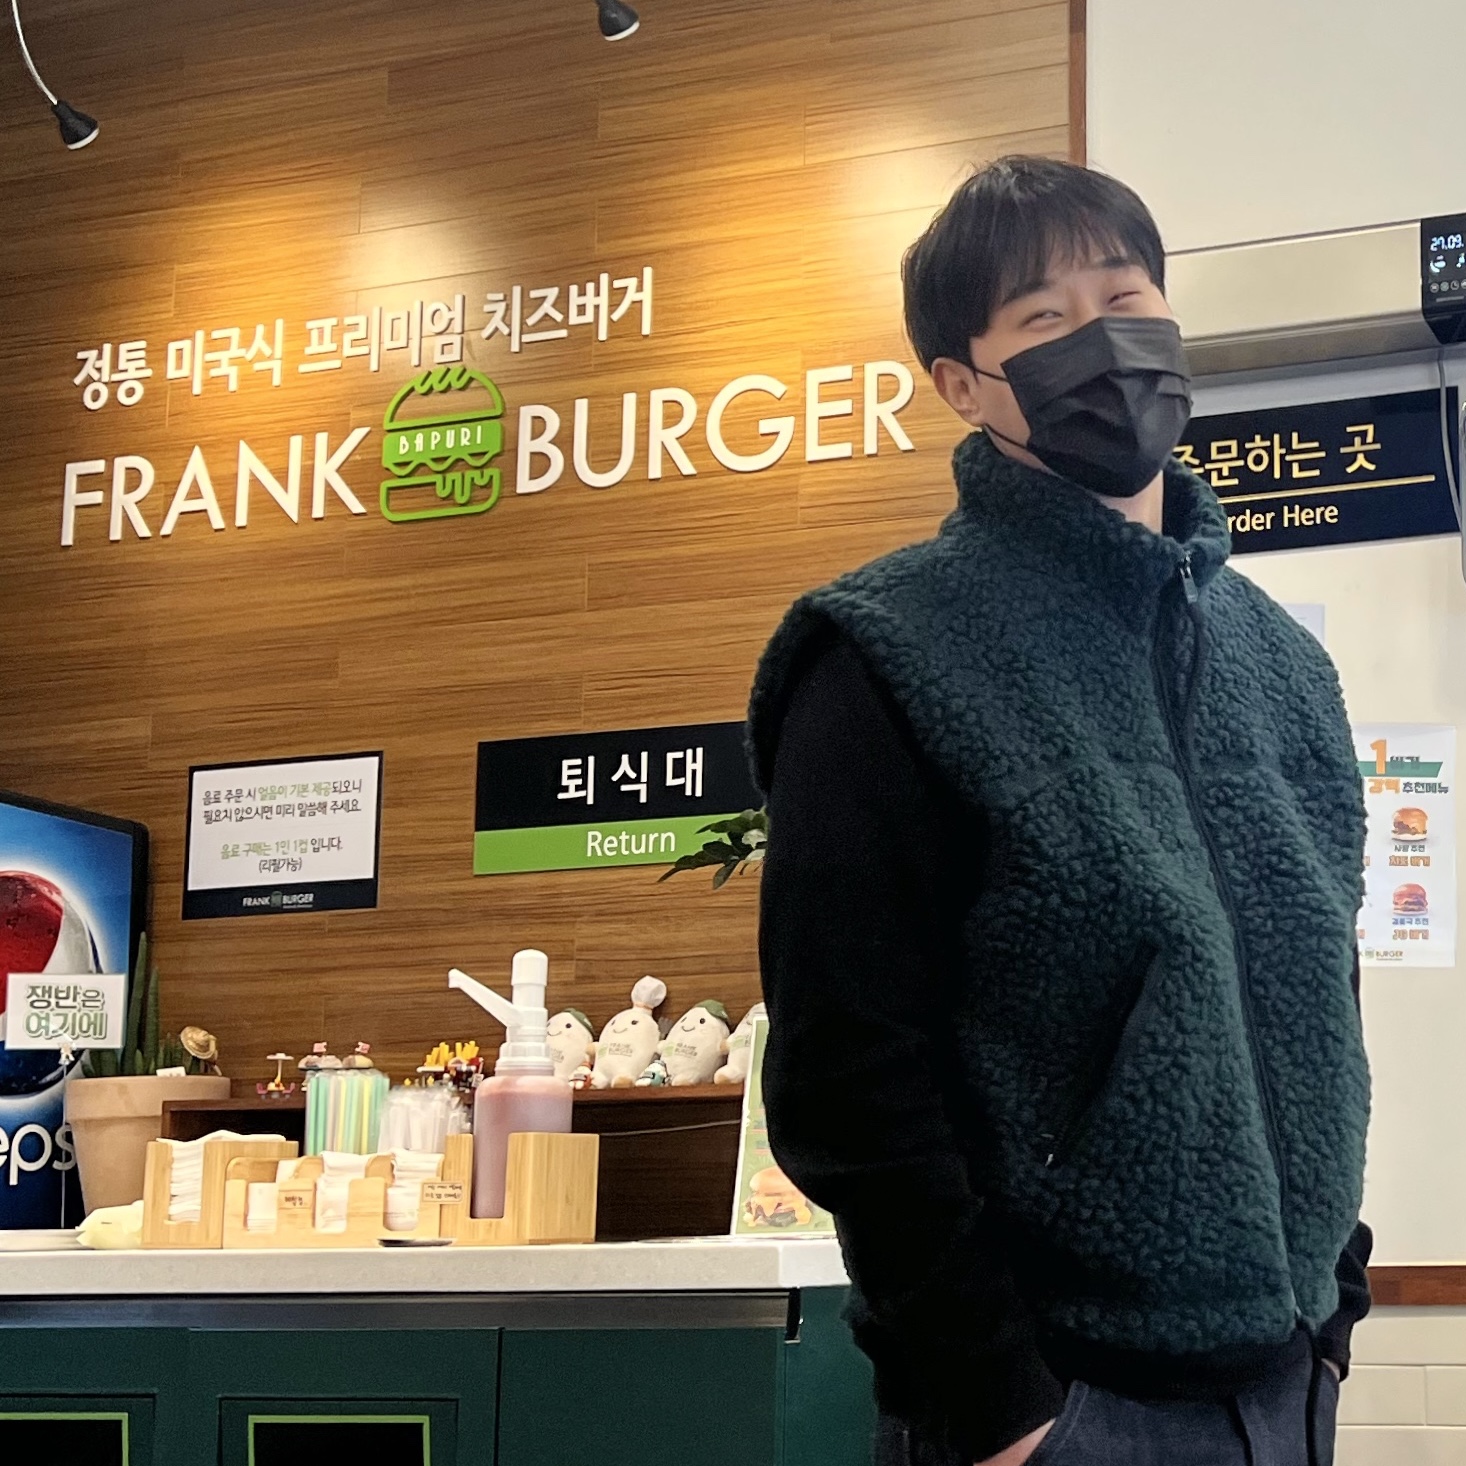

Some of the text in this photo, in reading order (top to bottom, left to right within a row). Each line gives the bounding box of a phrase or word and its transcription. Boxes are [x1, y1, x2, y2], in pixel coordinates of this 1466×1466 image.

[73, 266, 653, 411] 정통 미국식 프리미엄 치즈버거
[61, 360, 916, 547] FRANK BURGER
[398, 425, 482, 455] BAPURI
[1339, 423, 1381, 474] 곳
[1227, 504, 1339, 533] rder Here
[202, 779, 362, 806] 음료 주문 시 얼음이 기본 제공되오니
[234, 805, 273, 822] 않으시면
[275, 803, 295, 818] 미리
[297, 801, 328, 818] 말씀해
[220, 844, 240, 859] 음료
[242, 842, 272, 857] 구매는
[275, 840, 290, 855] 1인
[586, 830, 676, 857] Return
[243, 895, 270, 907] FRANK
[283, 893, 314, 905] BURGER
[26, 984, 105, 1010] 쟁반은
[24, 1010, 108, 1040] 여기에
